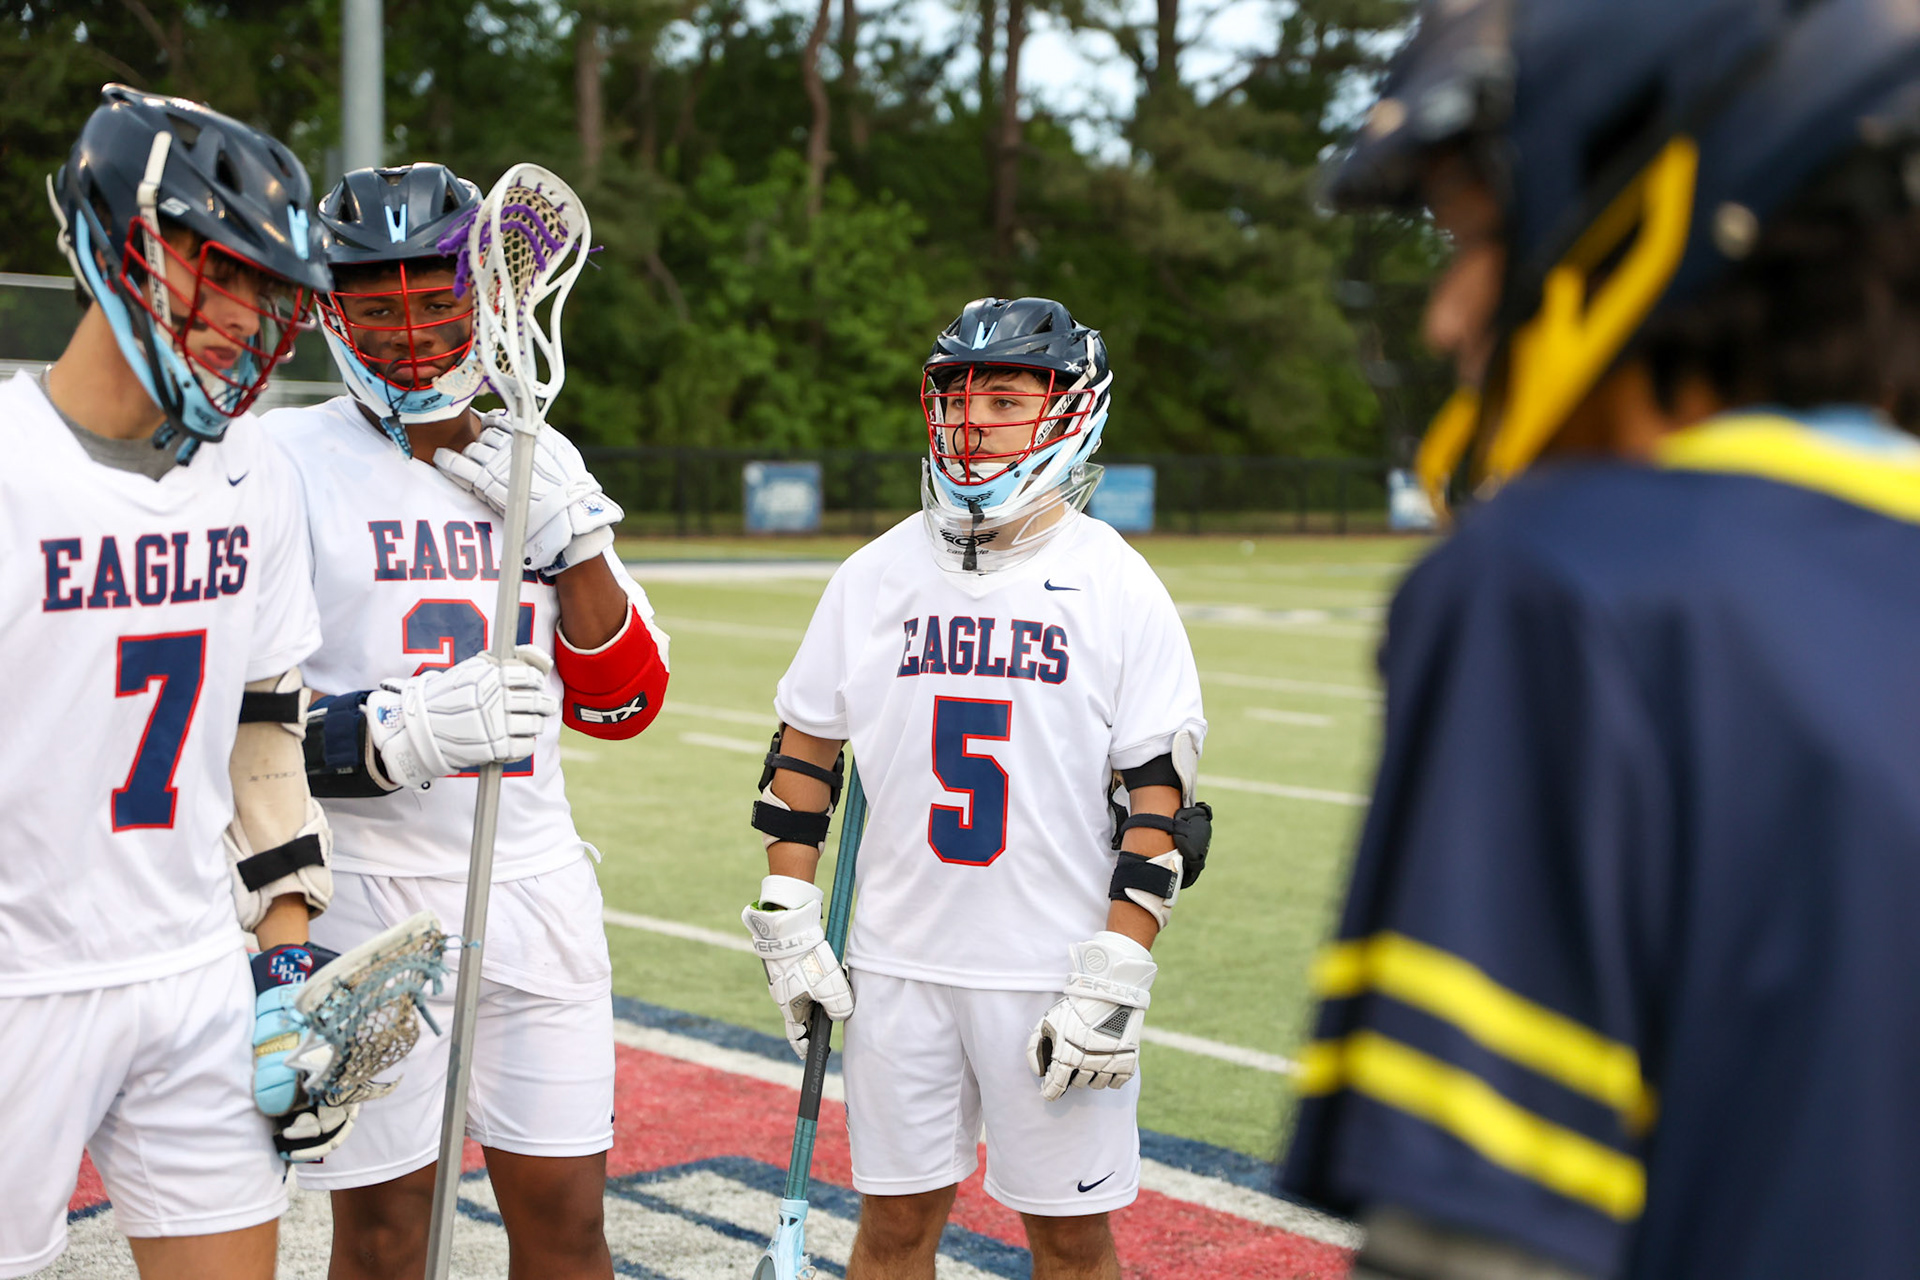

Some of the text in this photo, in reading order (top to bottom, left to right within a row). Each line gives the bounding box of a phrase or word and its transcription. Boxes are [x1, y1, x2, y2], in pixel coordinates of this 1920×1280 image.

[40, 525, 249, 613] EAGLES
[368, 520, 556, 586] EAGL
[897, 615, 1070, 685] EAGLES
[110, 628, 207, 833] 7
[580, 697, 642, 723] STX
[928, 695, 1013, 867] 5
